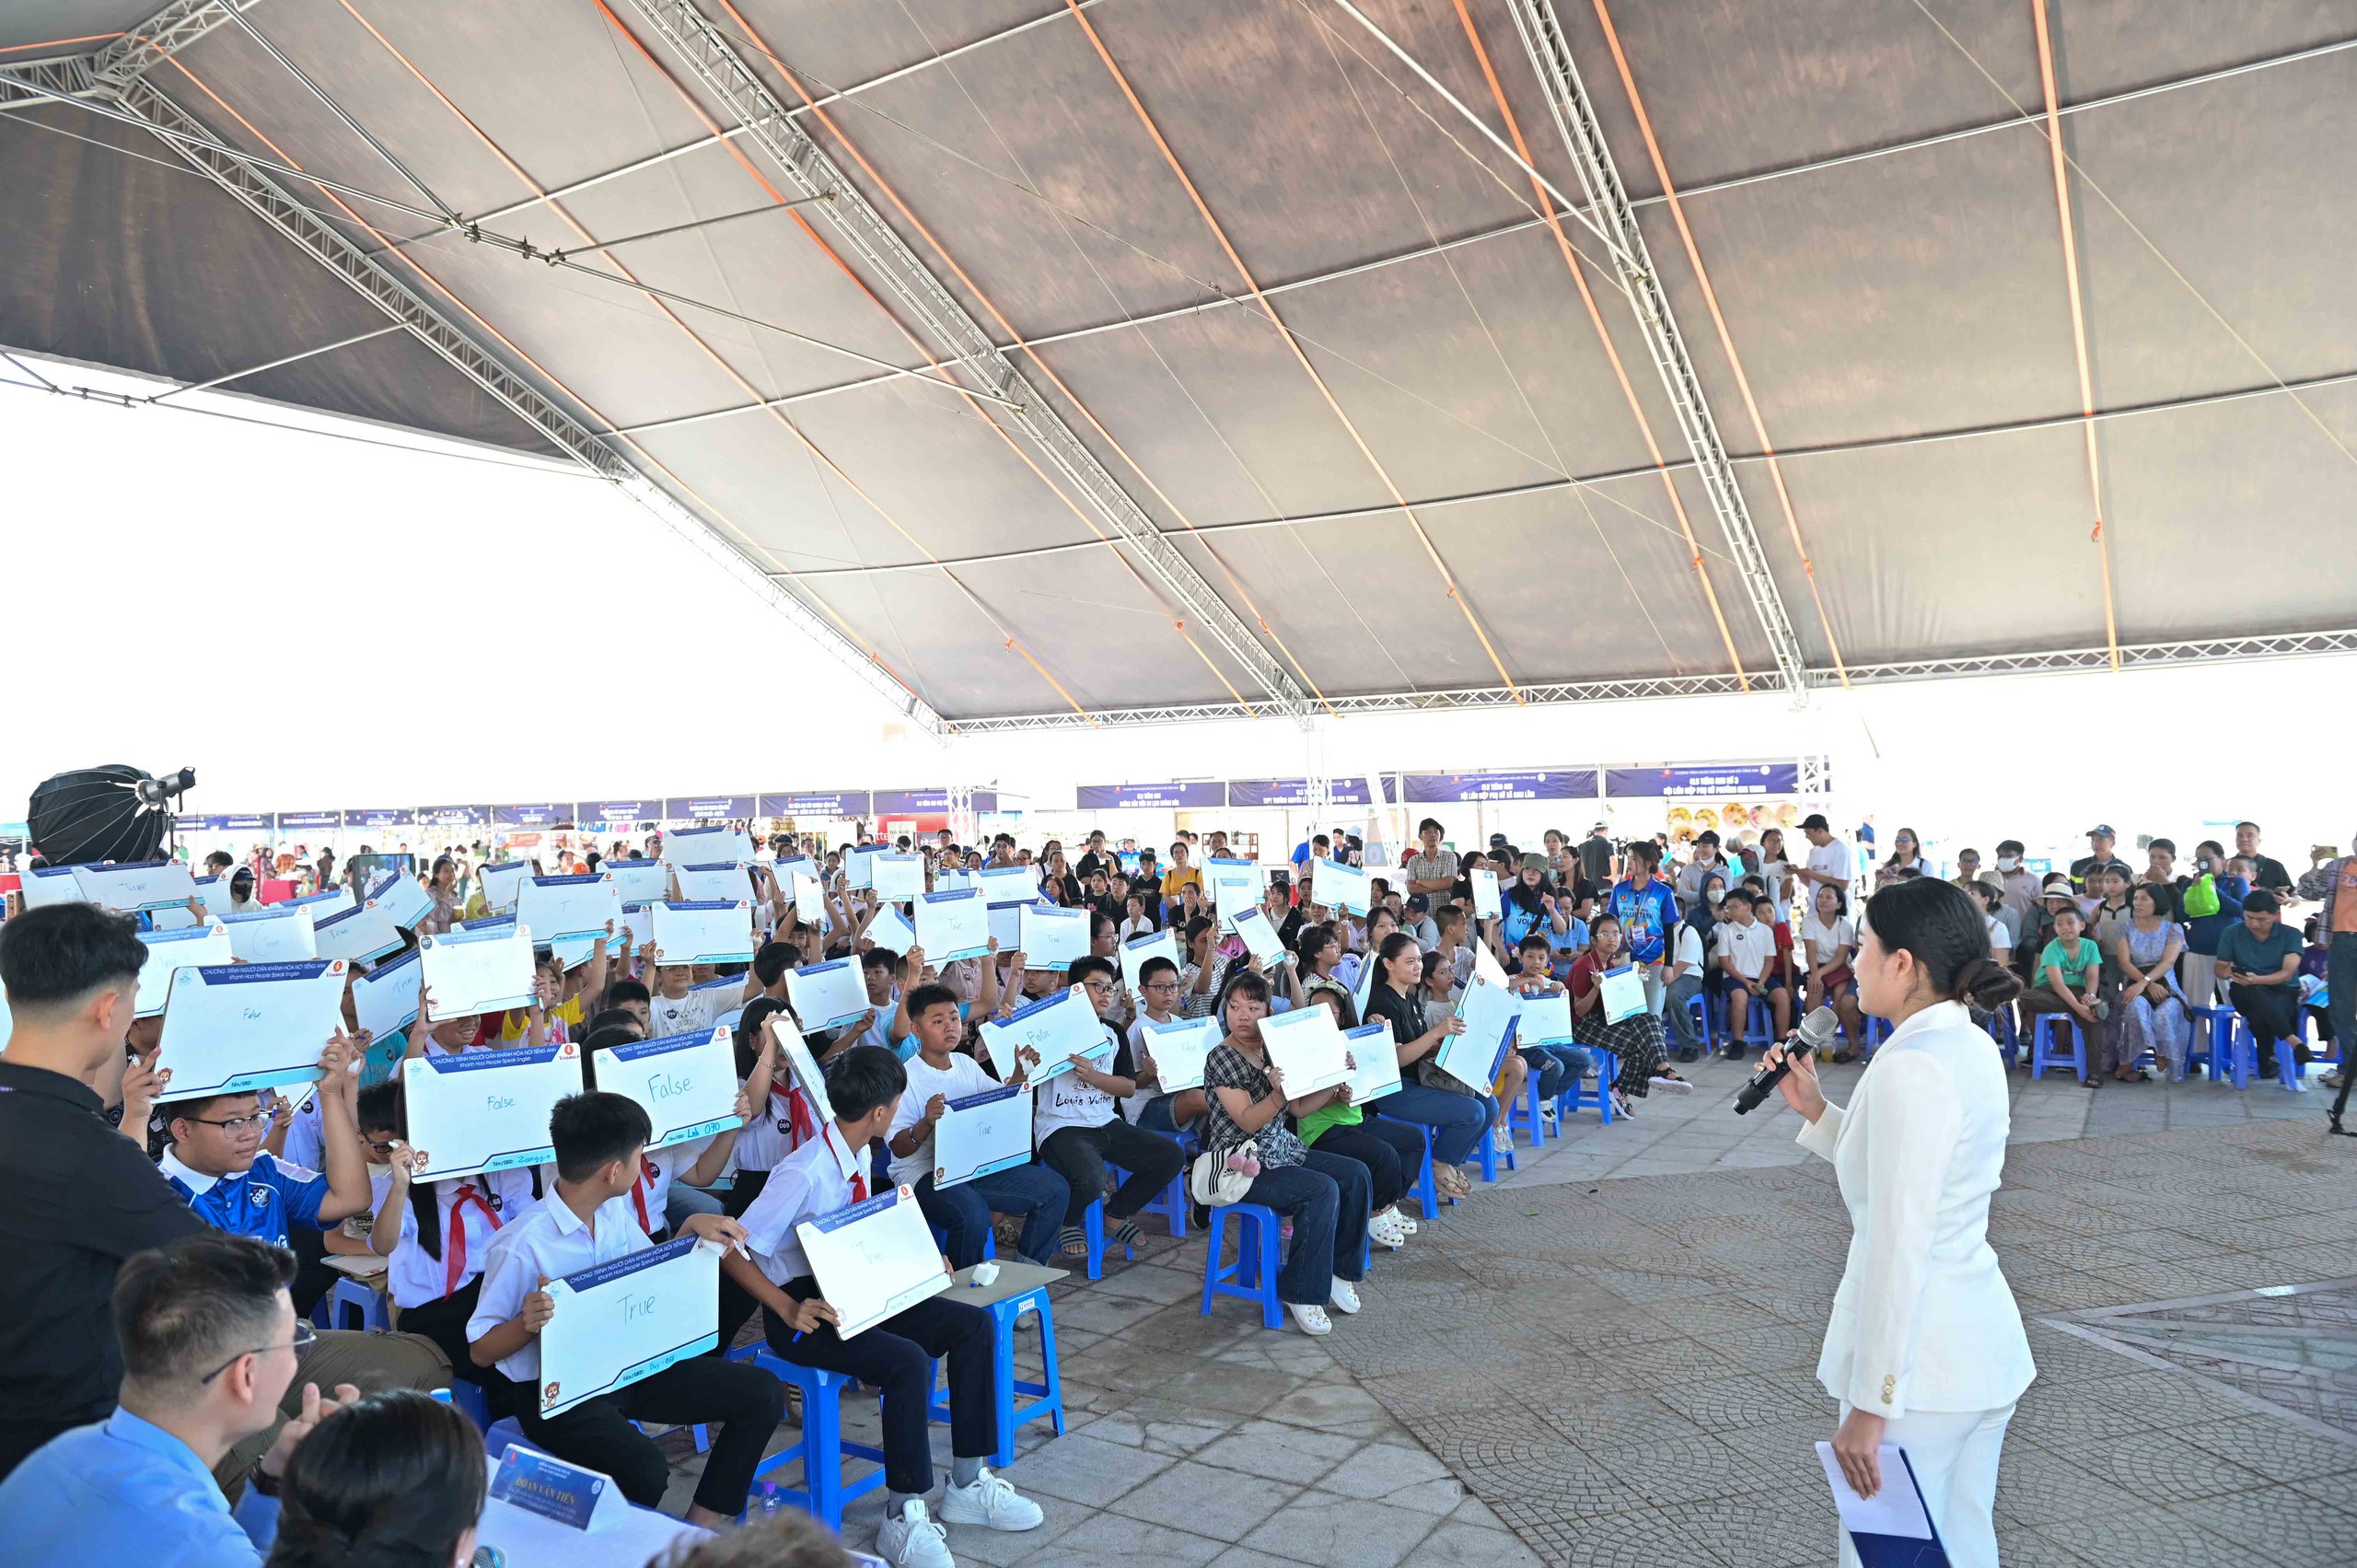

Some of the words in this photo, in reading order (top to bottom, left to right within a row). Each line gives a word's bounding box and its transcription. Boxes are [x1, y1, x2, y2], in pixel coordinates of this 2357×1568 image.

[647, 1074, 693, 1103] False
[487, 1095, 517, 1111] False
[1056, 1093, 1084, 1107] Louis
[704, 1121, 721, 1134] 070
[779, 1121, 790, 1130] 069
[252, 1189, 267, 1204] 032
[598, 1271, 612, 1280] Khanh
[624, 1261, 640, 1272] People
[641, 1257, 654, 1267] Speak
[656, 1251, 669, 1261] English
[616, 1293, 656, 1325] True
